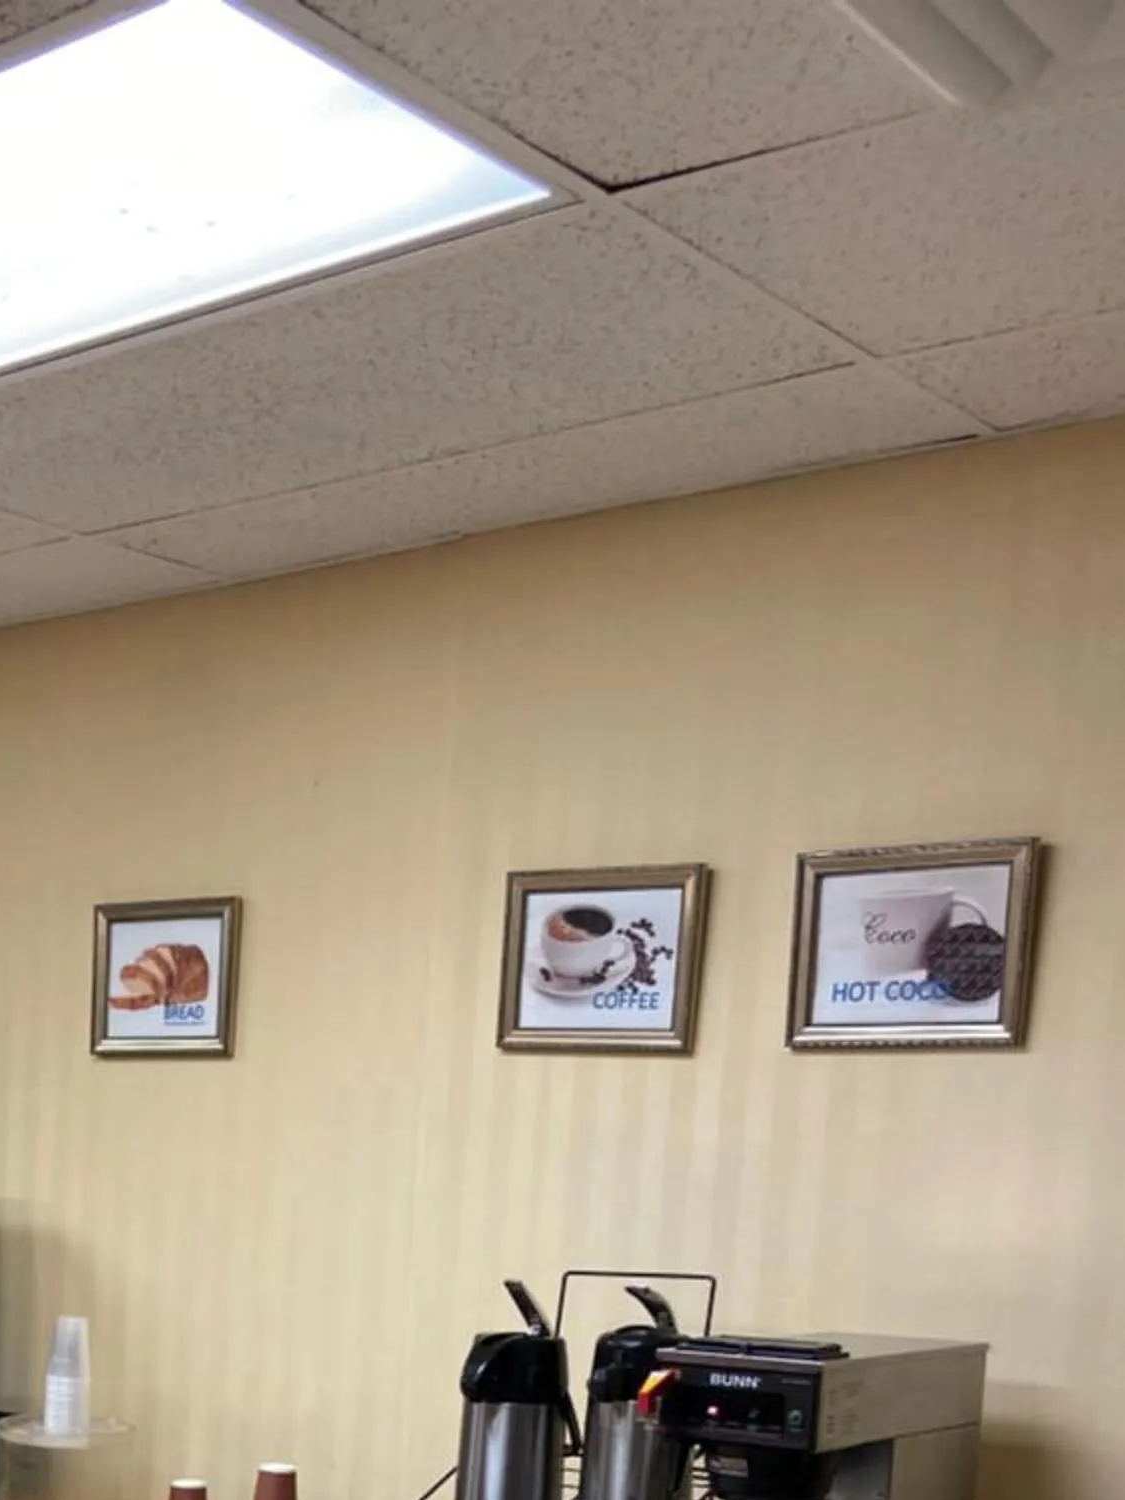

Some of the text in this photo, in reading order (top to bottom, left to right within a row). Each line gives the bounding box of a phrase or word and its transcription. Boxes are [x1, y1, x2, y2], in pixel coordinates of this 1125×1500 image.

[863, 911, 916, 944] Coco
[831, 978, 959, 1003] HOT COCO
[592, 991, 660, 1010] COFFEE
[163, 1003, 205, 1020] BREAD
[709, 1372, 762, 1389] BUNN
